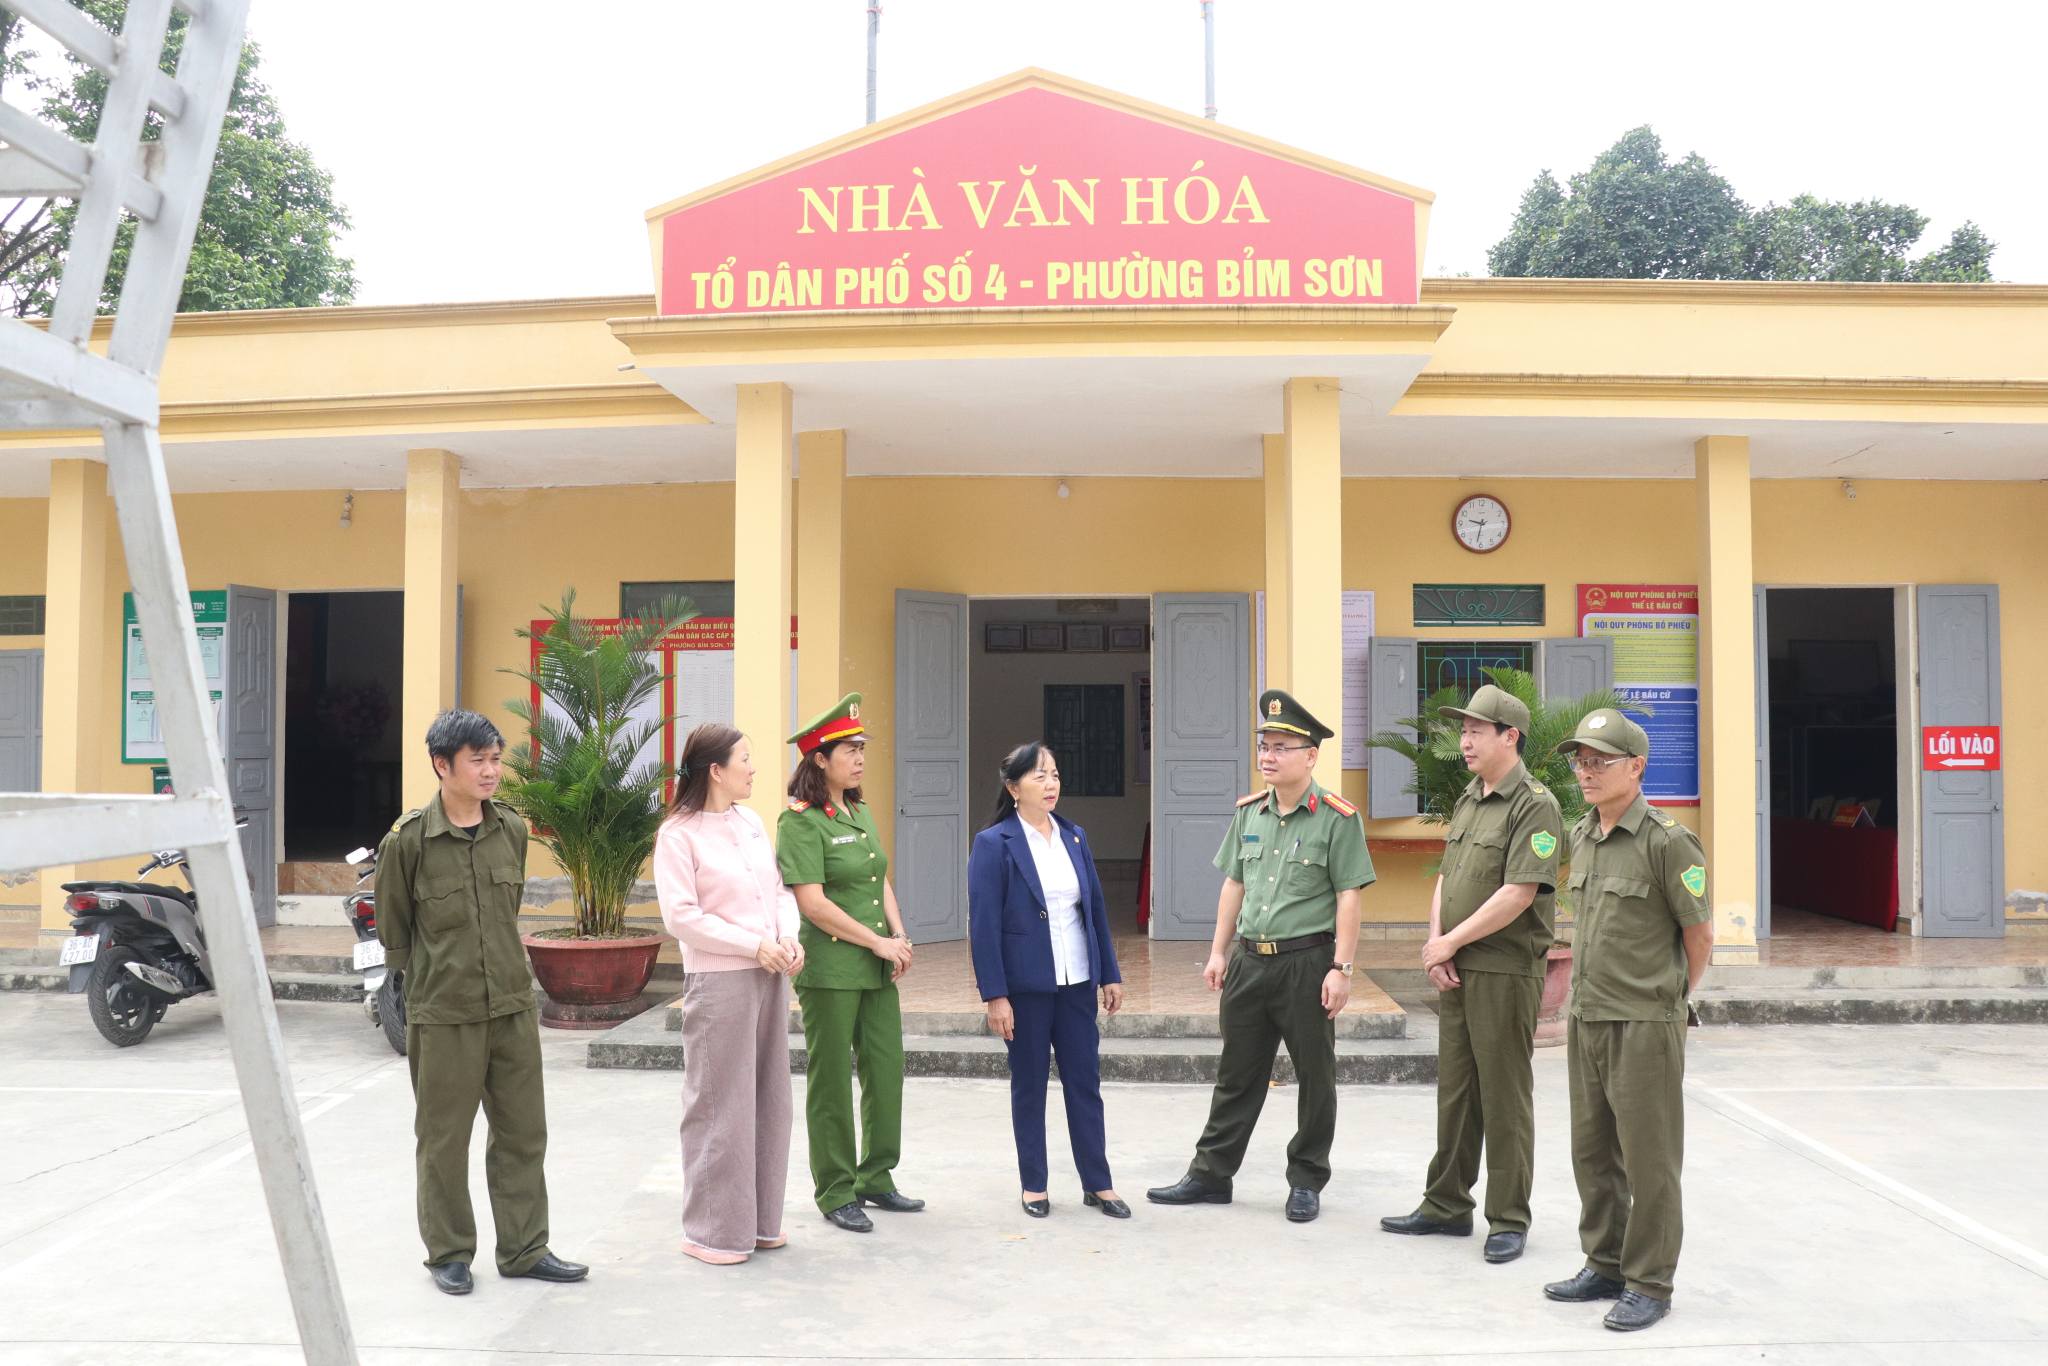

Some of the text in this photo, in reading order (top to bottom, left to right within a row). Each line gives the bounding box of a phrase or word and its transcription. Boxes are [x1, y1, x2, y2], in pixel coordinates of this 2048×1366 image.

[797, 160, 1270, 235] NHÀ VĂN HÓA
[690, 245, 1384, 309] TỔ DÂN PHỐ SỐ 4 - PHƯỜNG BỈM SƠN
[1624, 591, 1638, 599] QUY
[1610, 621, 1625, 629] QUY
[1929, 731, 1994, 754] LỐI VÀO
